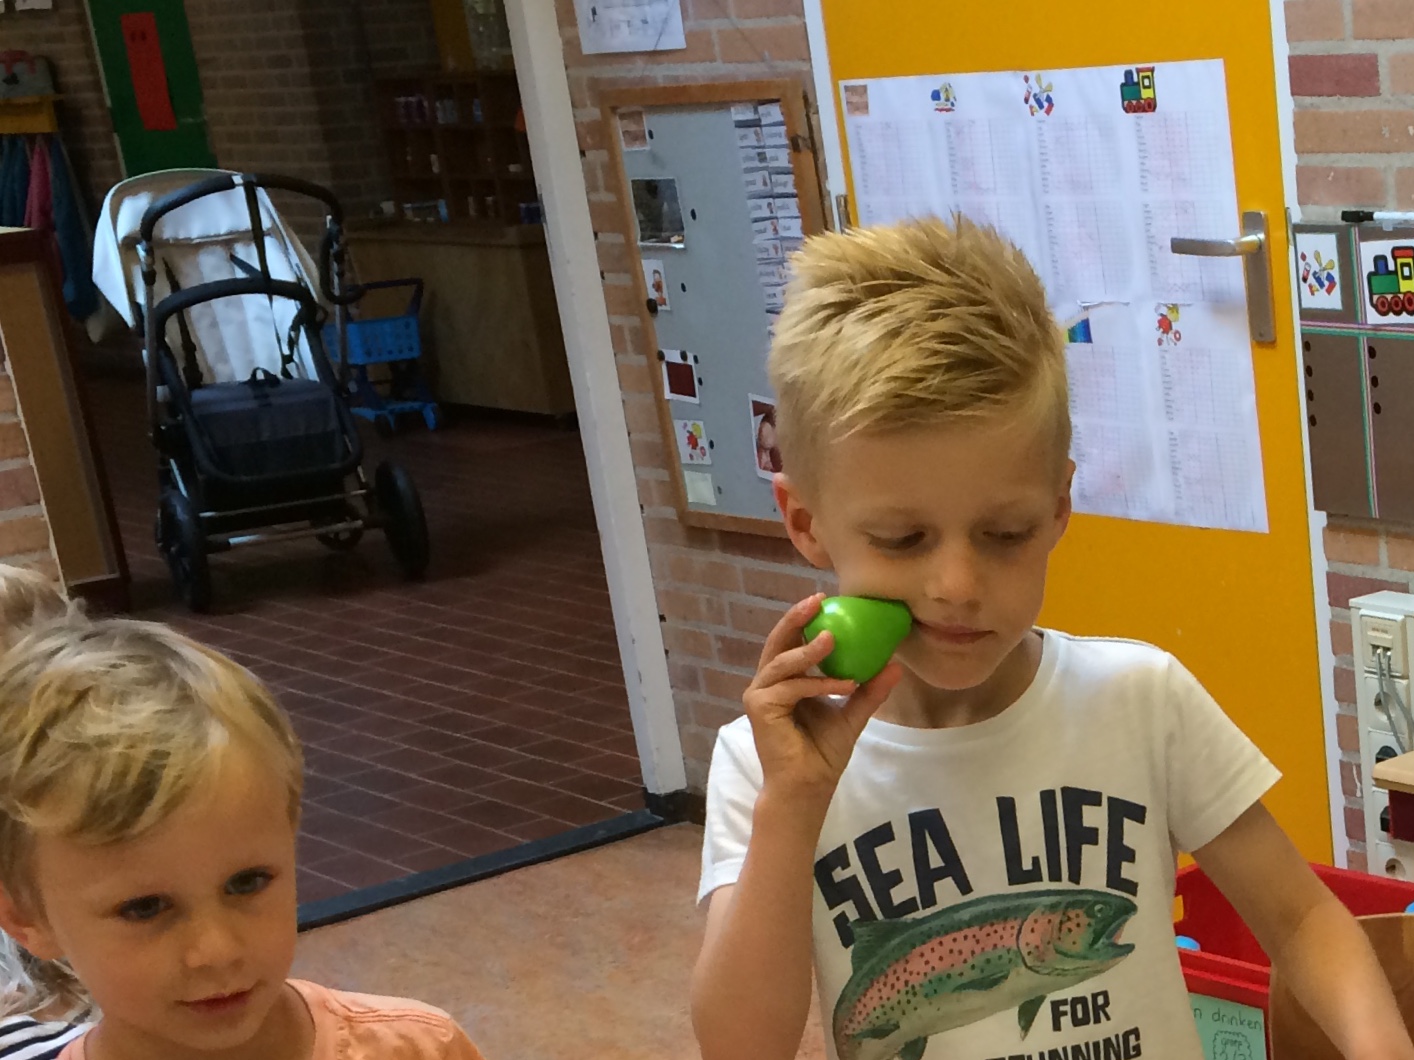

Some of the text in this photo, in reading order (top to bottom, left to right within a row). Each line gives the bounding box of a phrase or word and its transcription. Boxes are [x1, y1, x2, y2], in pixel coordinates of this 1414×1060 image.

[813, 786, 1147, 949] SEA LIFE
[1050, 990, 1112, 1032] FOR
[1212, 1008, 1262, 1032] drinken
